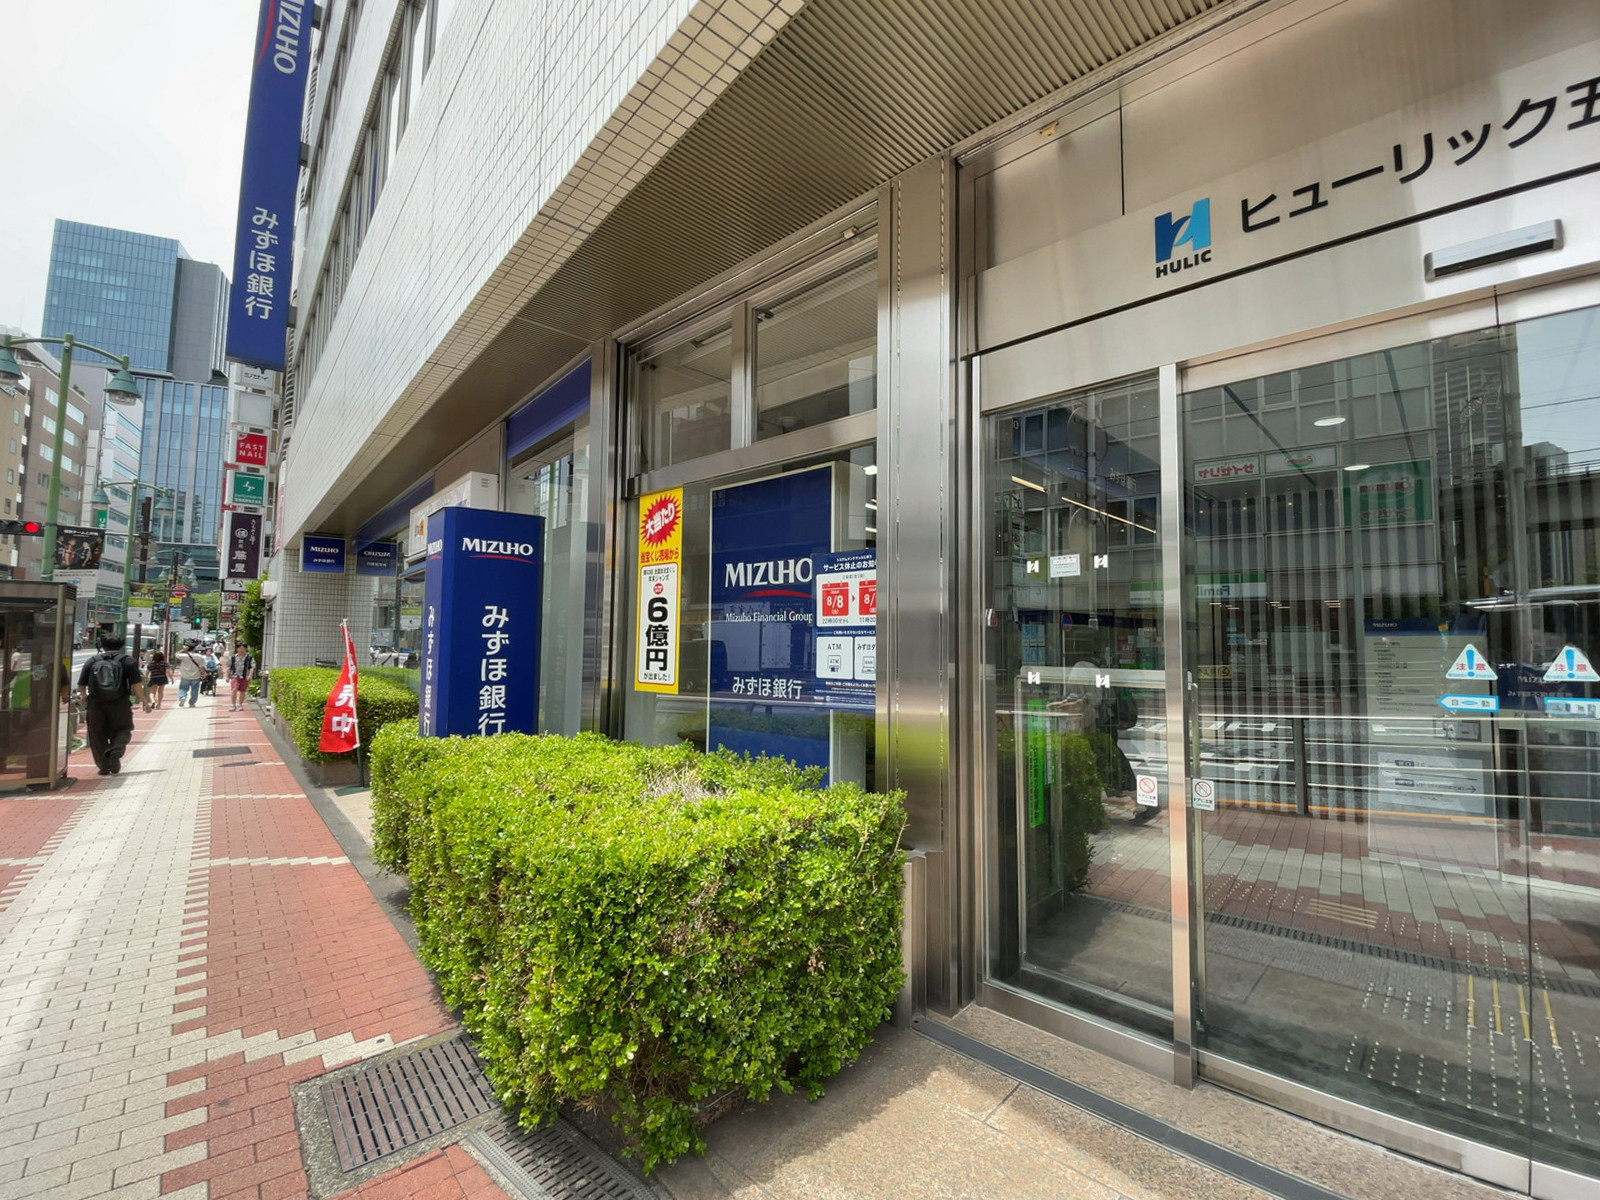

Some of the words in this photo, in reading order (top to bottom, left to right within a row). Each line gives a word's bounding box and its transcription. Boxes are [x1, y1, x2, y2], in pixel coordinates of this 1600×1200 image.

[273, 0, 305, 74] IZUHO
[245, 207, 279, 319] みずほ銀行
[1155, 249, 1212, 279] HULIC
[239, 442, 265, 451] FAST
[239, 450, 264, 459] NAIL
[645, 502, 676, 539] 大当たり
[309, 545, 340, 554] MIZUHO
[427, 538, 443, 556] MIZUHO
[462, 537, 534, 556] MIZUHO
[724, 558, 813, 588] MIZUHO
[826, 595, 844, 609] 8/8
[864, 592, 876, 608] 8/
[726, 613, 752, 623] Mizuho
[753, 610, 787, 622] Financial
[645, 597, 669, 671] 6億円
[478, 605, 509, 737] みずほ銀行
[732, 676, 803, 700] みずほ銀行
